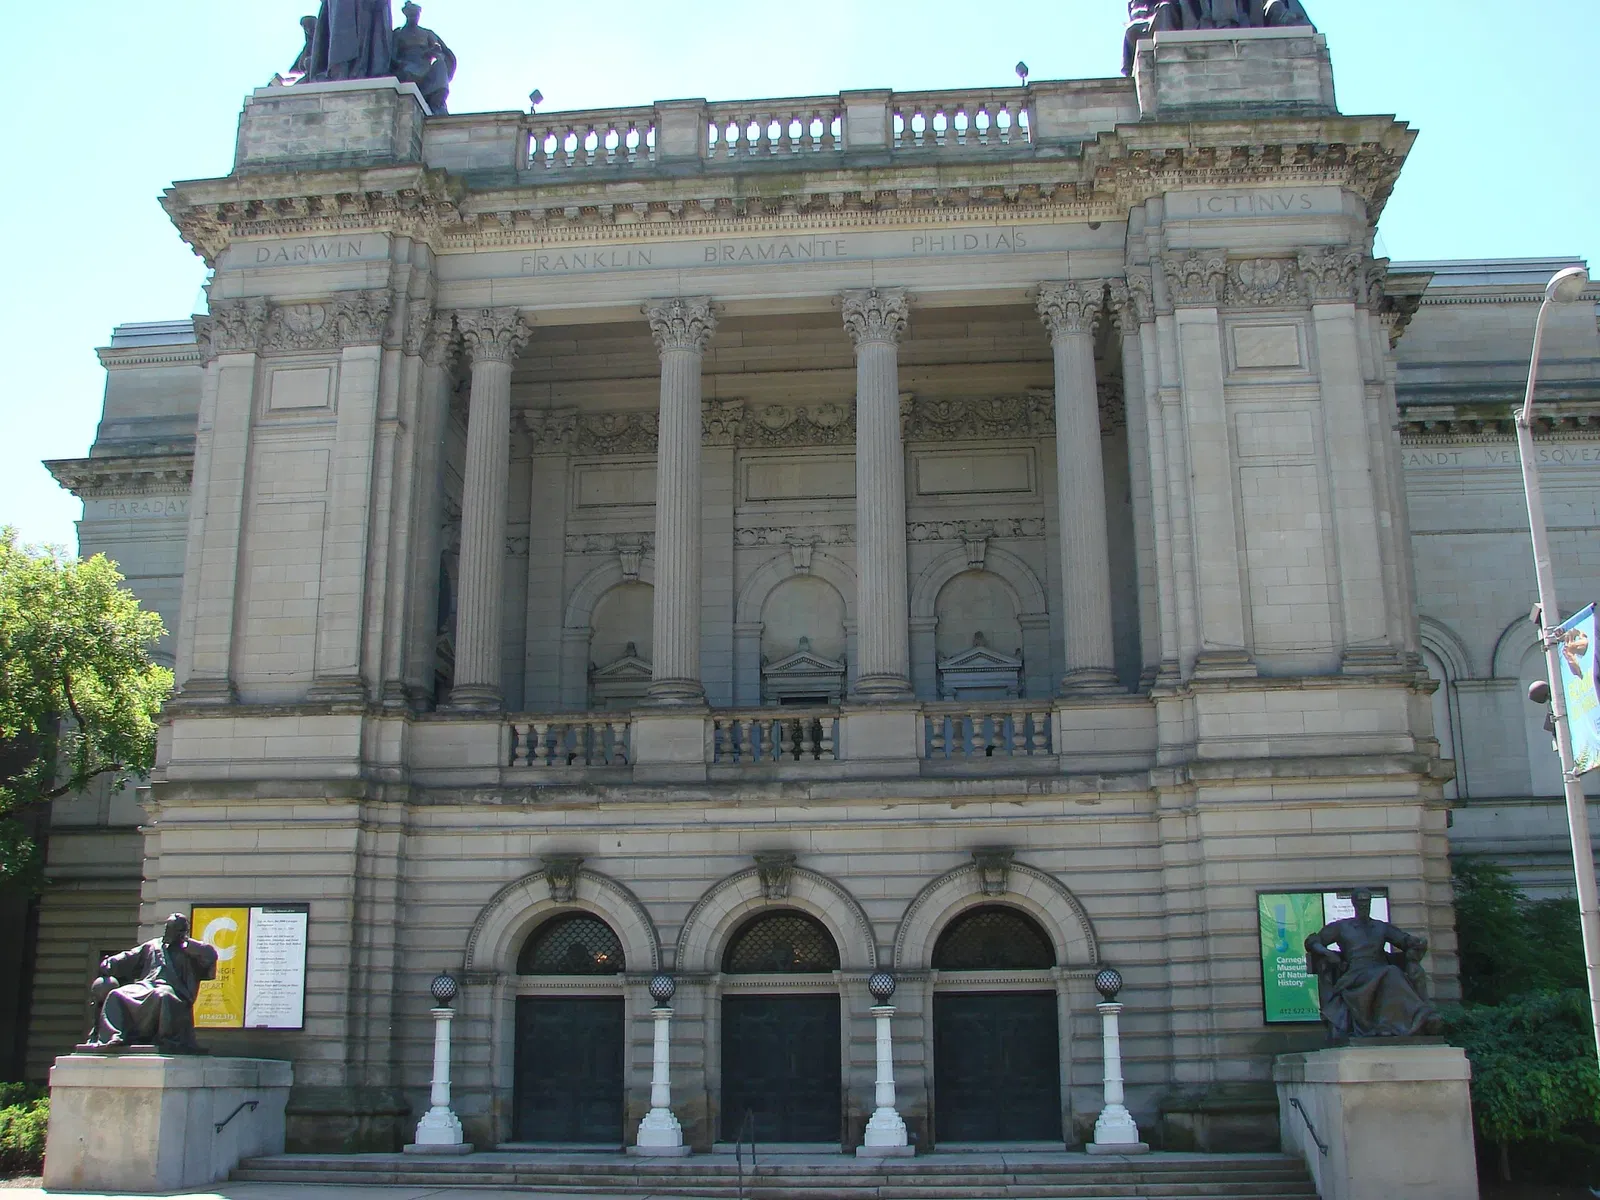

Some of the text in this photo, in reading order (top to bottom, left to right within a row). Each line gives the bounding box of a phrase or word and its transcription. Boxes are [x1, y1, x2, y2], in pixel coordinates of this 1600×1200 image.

[1196, 193, 1312, 213] ICTINVS
[256, 240, 362, 263] DARWIN
[704, 240, 848, 262] BRAMANTE
[912, 232, 1027, 252] PHIDIAS
[520, 250, 653, 273] FRANKLIN
[108, 500, 188, 517] FARADAY
[1278, 979, 1304, 987] History
